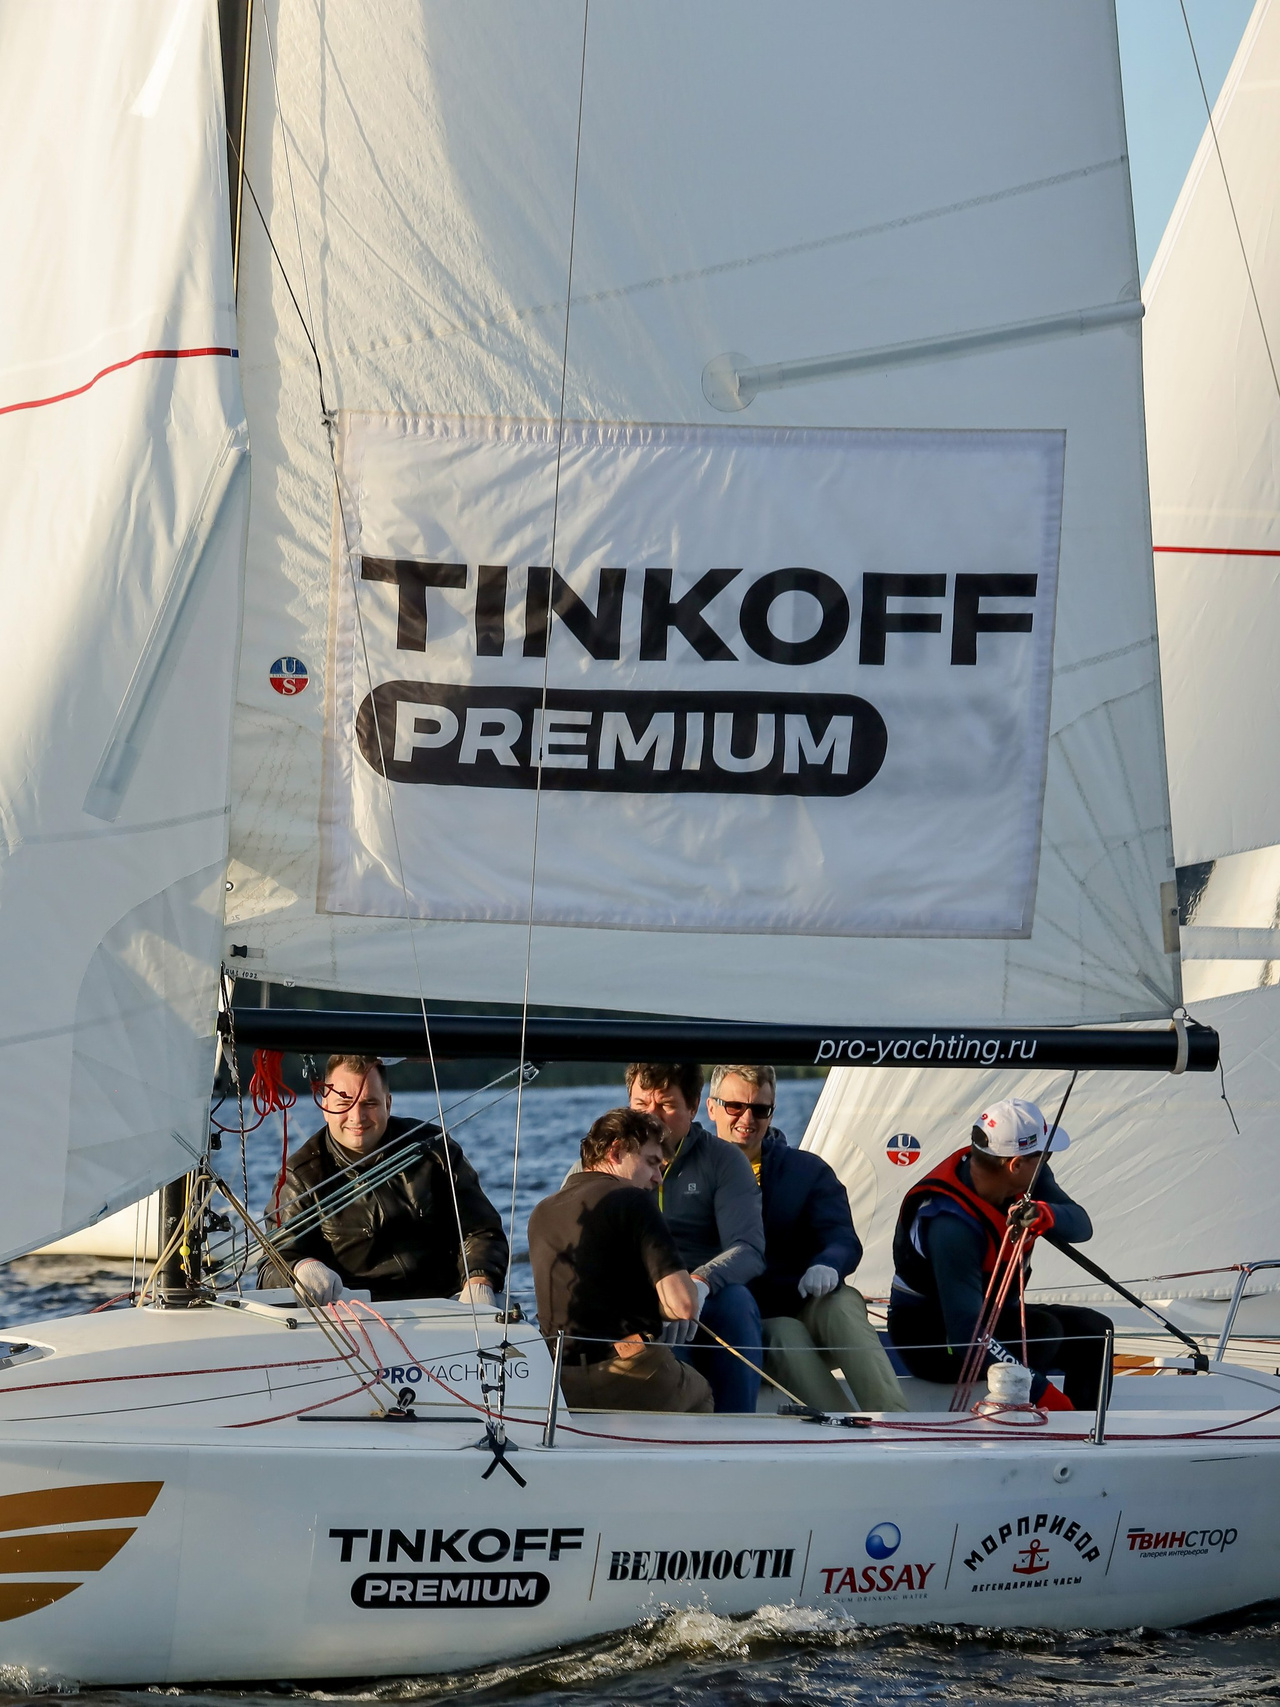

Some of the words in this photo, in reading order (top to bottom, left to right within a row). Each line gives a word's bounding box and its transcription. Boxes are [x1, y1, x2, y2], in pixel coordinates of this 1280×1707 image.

[360, 556, 1038, 666] TINKOFF
[392, 700, 855, 775] PREMIUM
[814, 1034, 1038, 1065] pro-yachting.ru
[328, 1527, 585, 1563] TINKOFF
[963, 1514, 1101, 1572] МОРПРИБОР
[606, 1548, 796, 1584] ВЕДОМОСТИ
[819, 1562, 937, 1594] TASSAY
[971, 1579, 1049, 1592] ЛЕГЕНДАРНЫЕ
[1053, 1576, 1082, 1586] ЧАСЫ
[363, 1578, 538, 1602] PREMIUM
